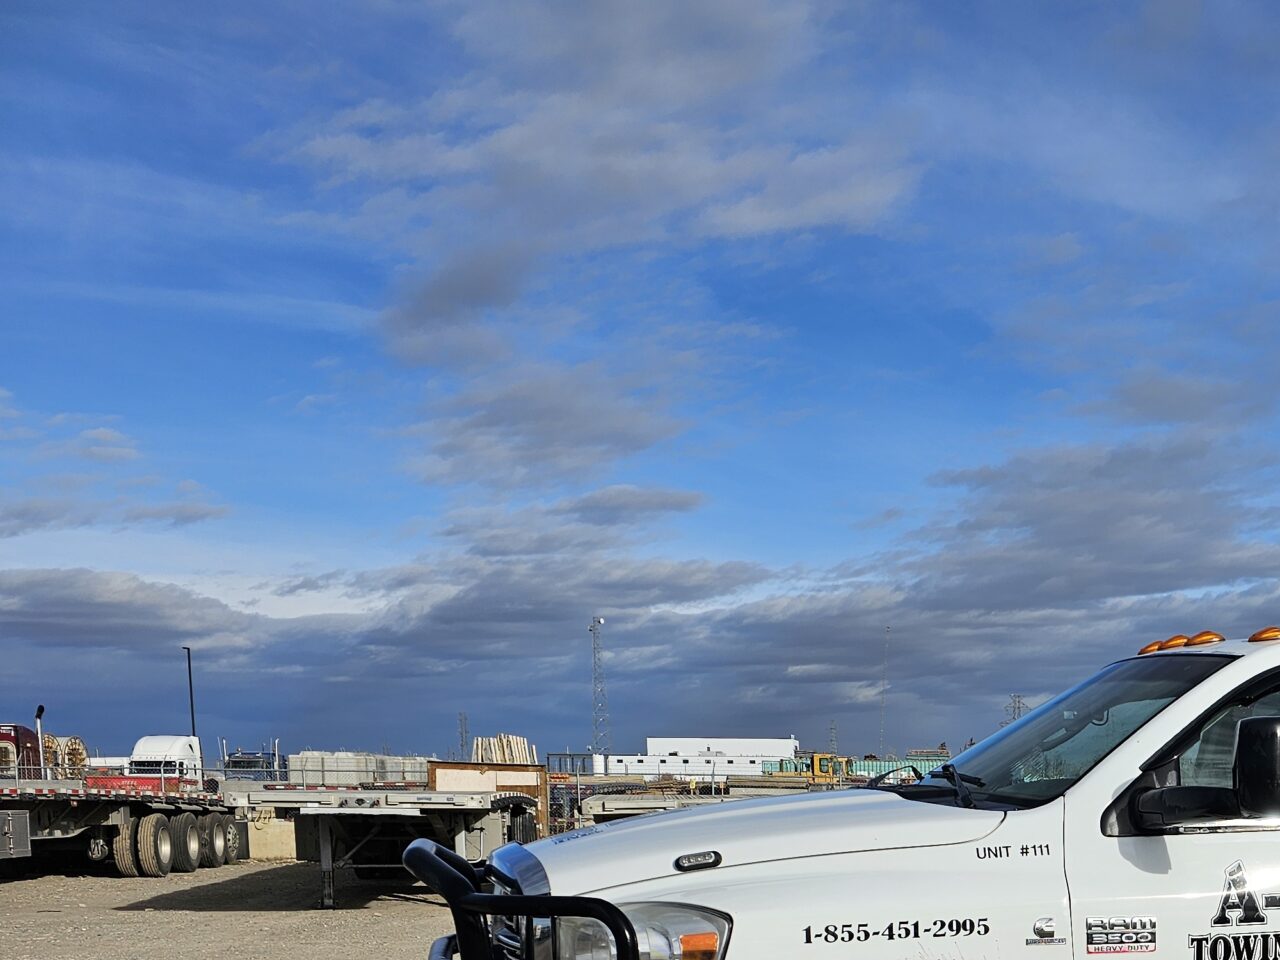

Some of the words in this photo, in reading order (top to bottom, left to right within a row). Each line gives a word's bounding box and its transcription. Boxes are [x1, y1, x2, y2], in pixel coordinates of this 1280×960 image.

[976, 845, 1011, 859] UNIT
[1020, 844, 1051, 856] #111
[1086, 916, 1156, 930] RAM
[802, 918, 990, 944] 1-855-451-2995
[1092, 933, 1152, 943] 3500
